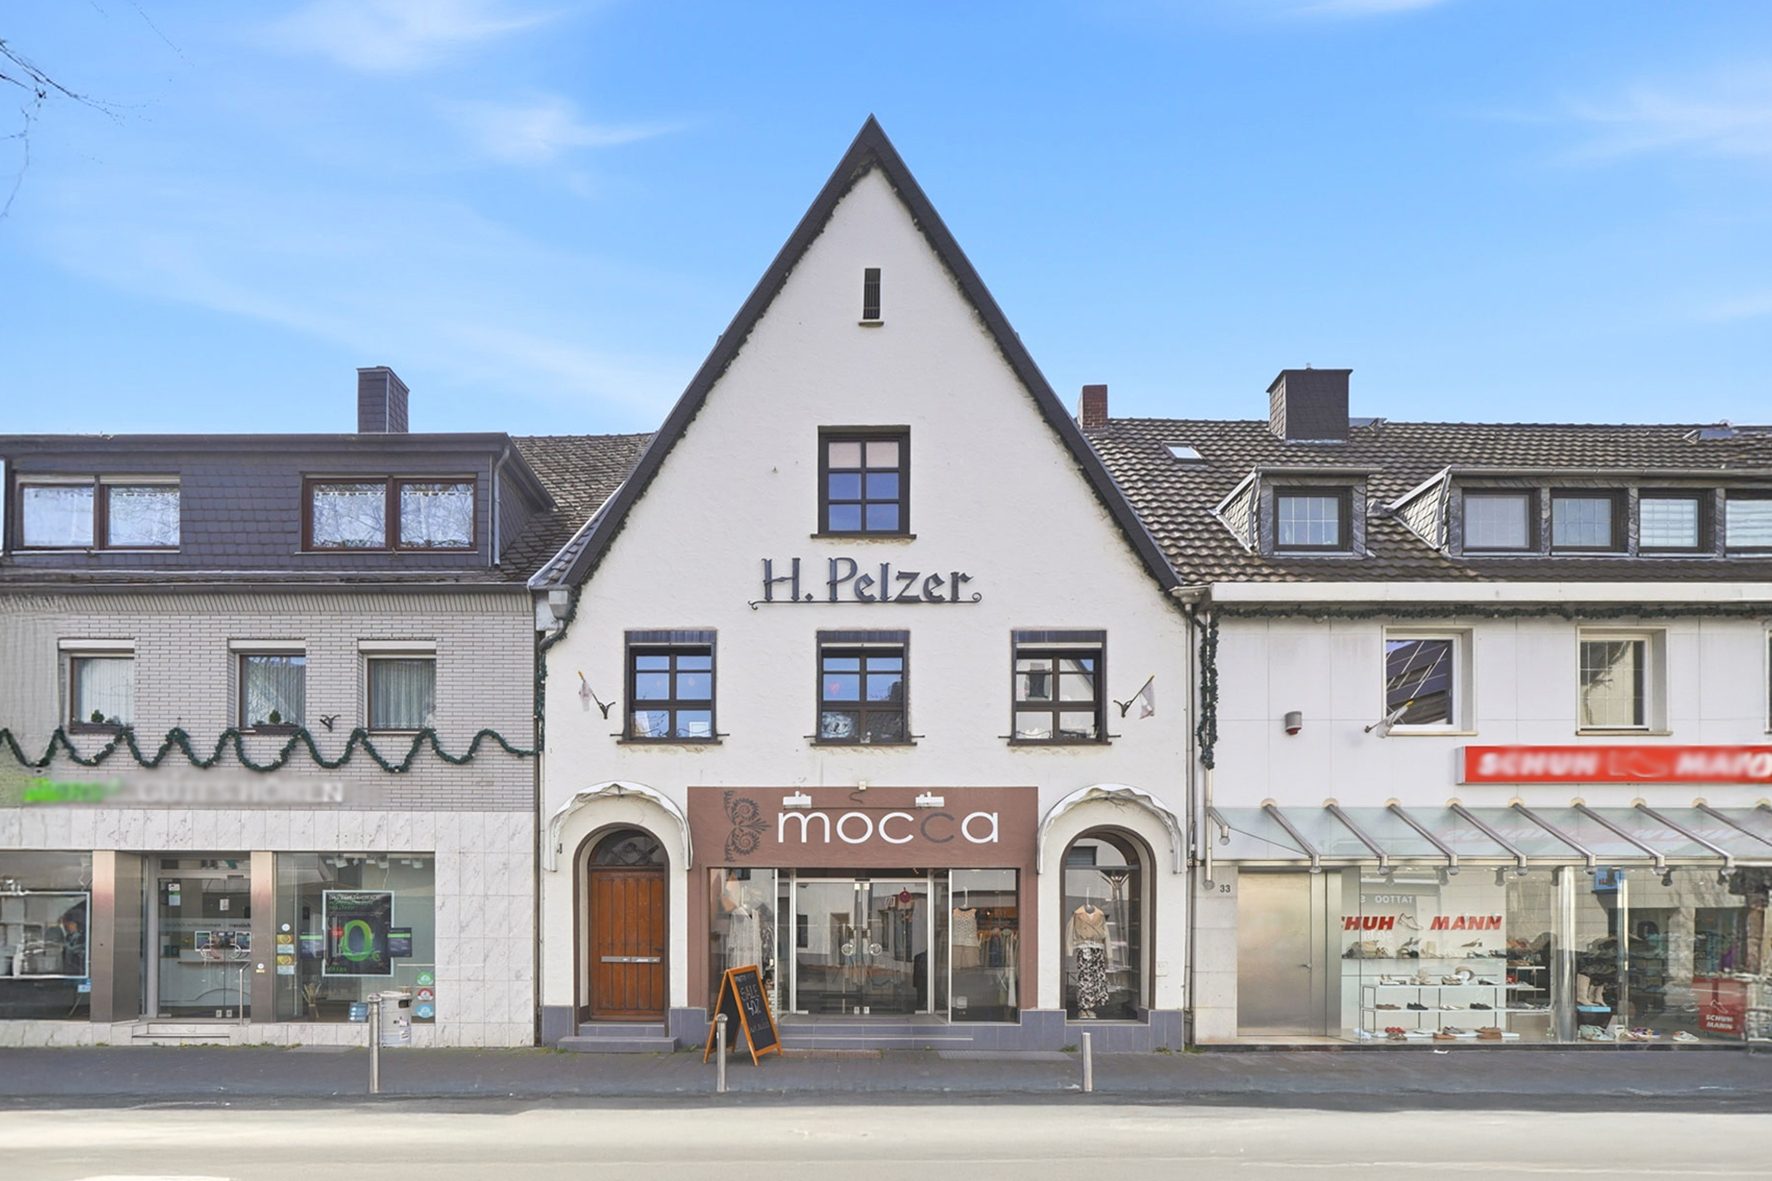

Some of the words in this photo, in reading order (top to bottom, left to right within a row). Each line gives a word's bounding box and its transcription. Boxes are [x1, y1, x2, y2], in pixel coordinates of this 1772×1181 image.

[761, 557, 814, 602] H.
[826, 557, 974, 603] Pelzer
[777, 811, 999, 844] mocca
[1219, 884, 1231, 893] 33
[1430, 915, 1503, 931] MANN
